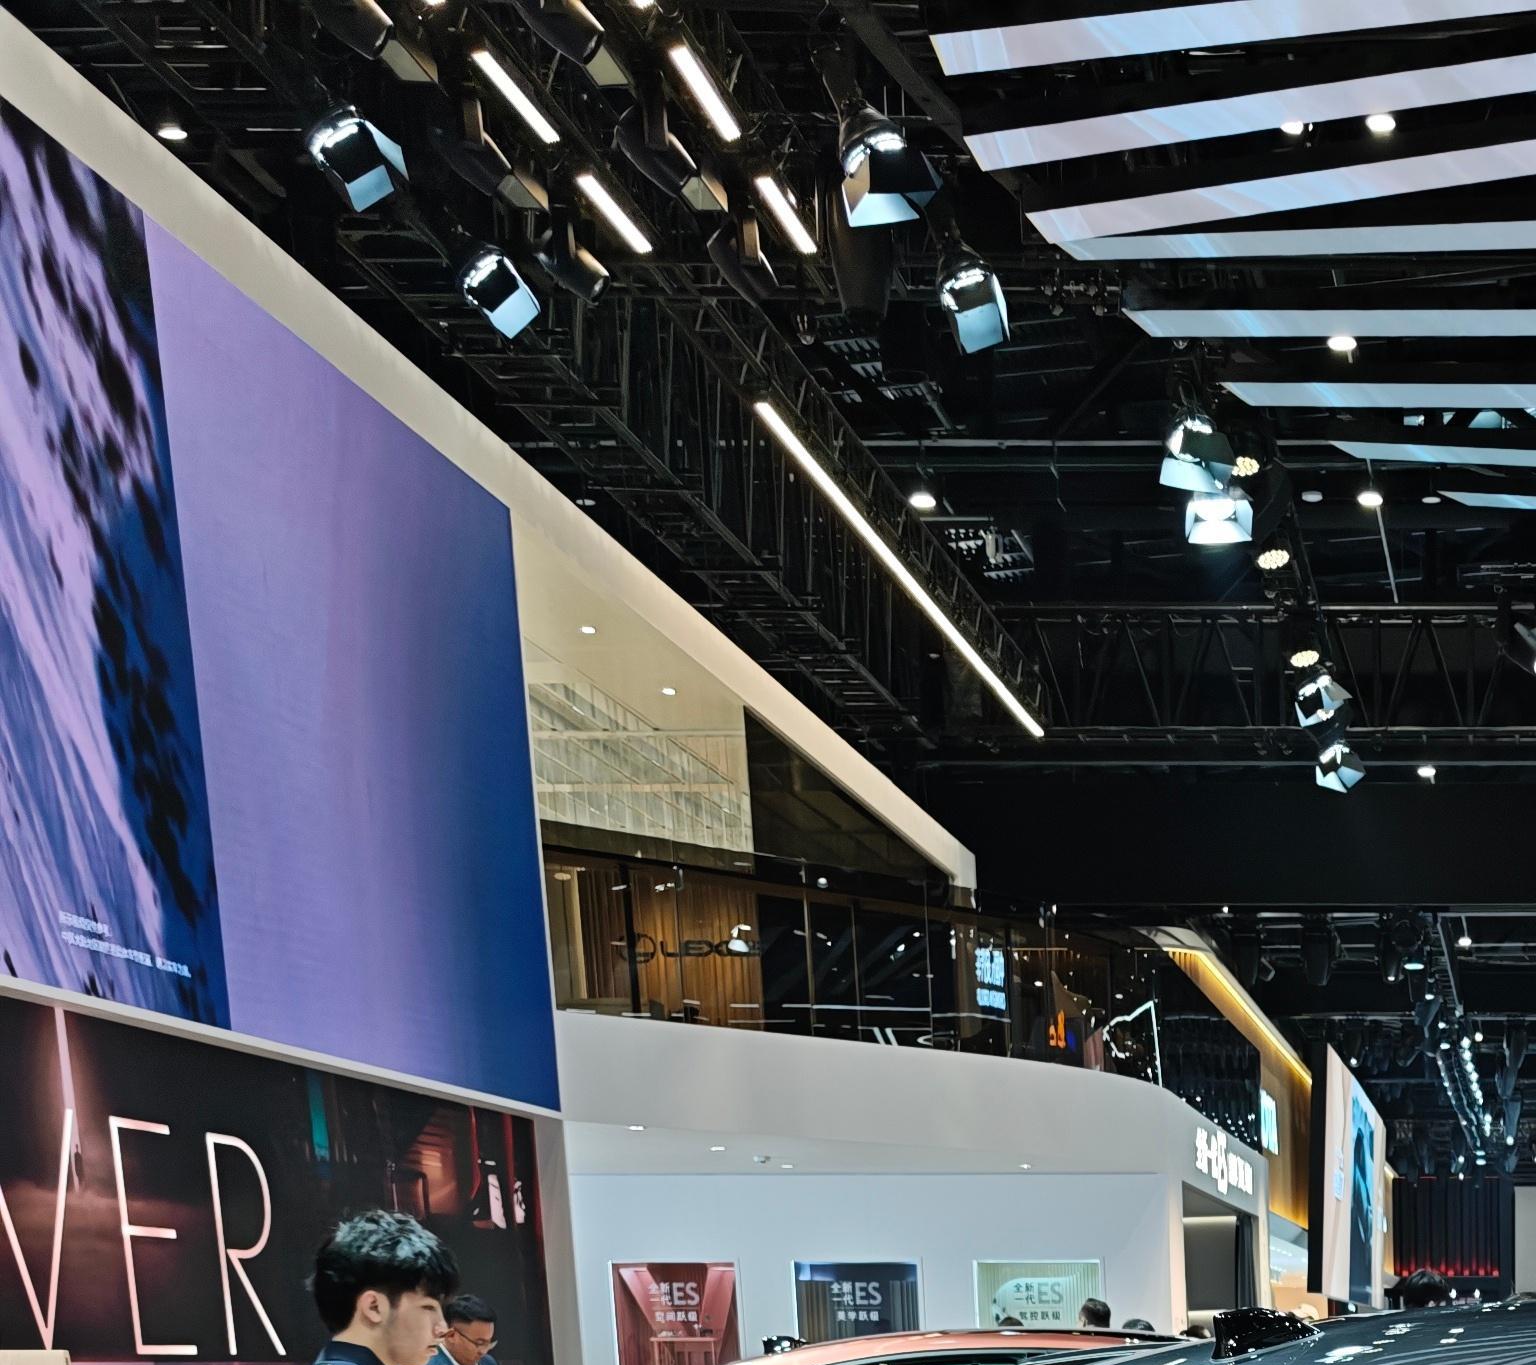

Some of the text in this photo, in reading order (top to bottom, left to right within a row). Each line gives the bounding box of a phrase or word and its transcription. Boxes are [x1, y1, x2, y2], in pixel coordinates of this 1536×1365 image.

[659, 939, 761, 958] LEX
[0, 1107, 287, 1356] VER
[672, 1282, 700, 1306] ES
[855, 1281, 882, 1306] ES
[1037, 1282, 1064, 1305] ES
